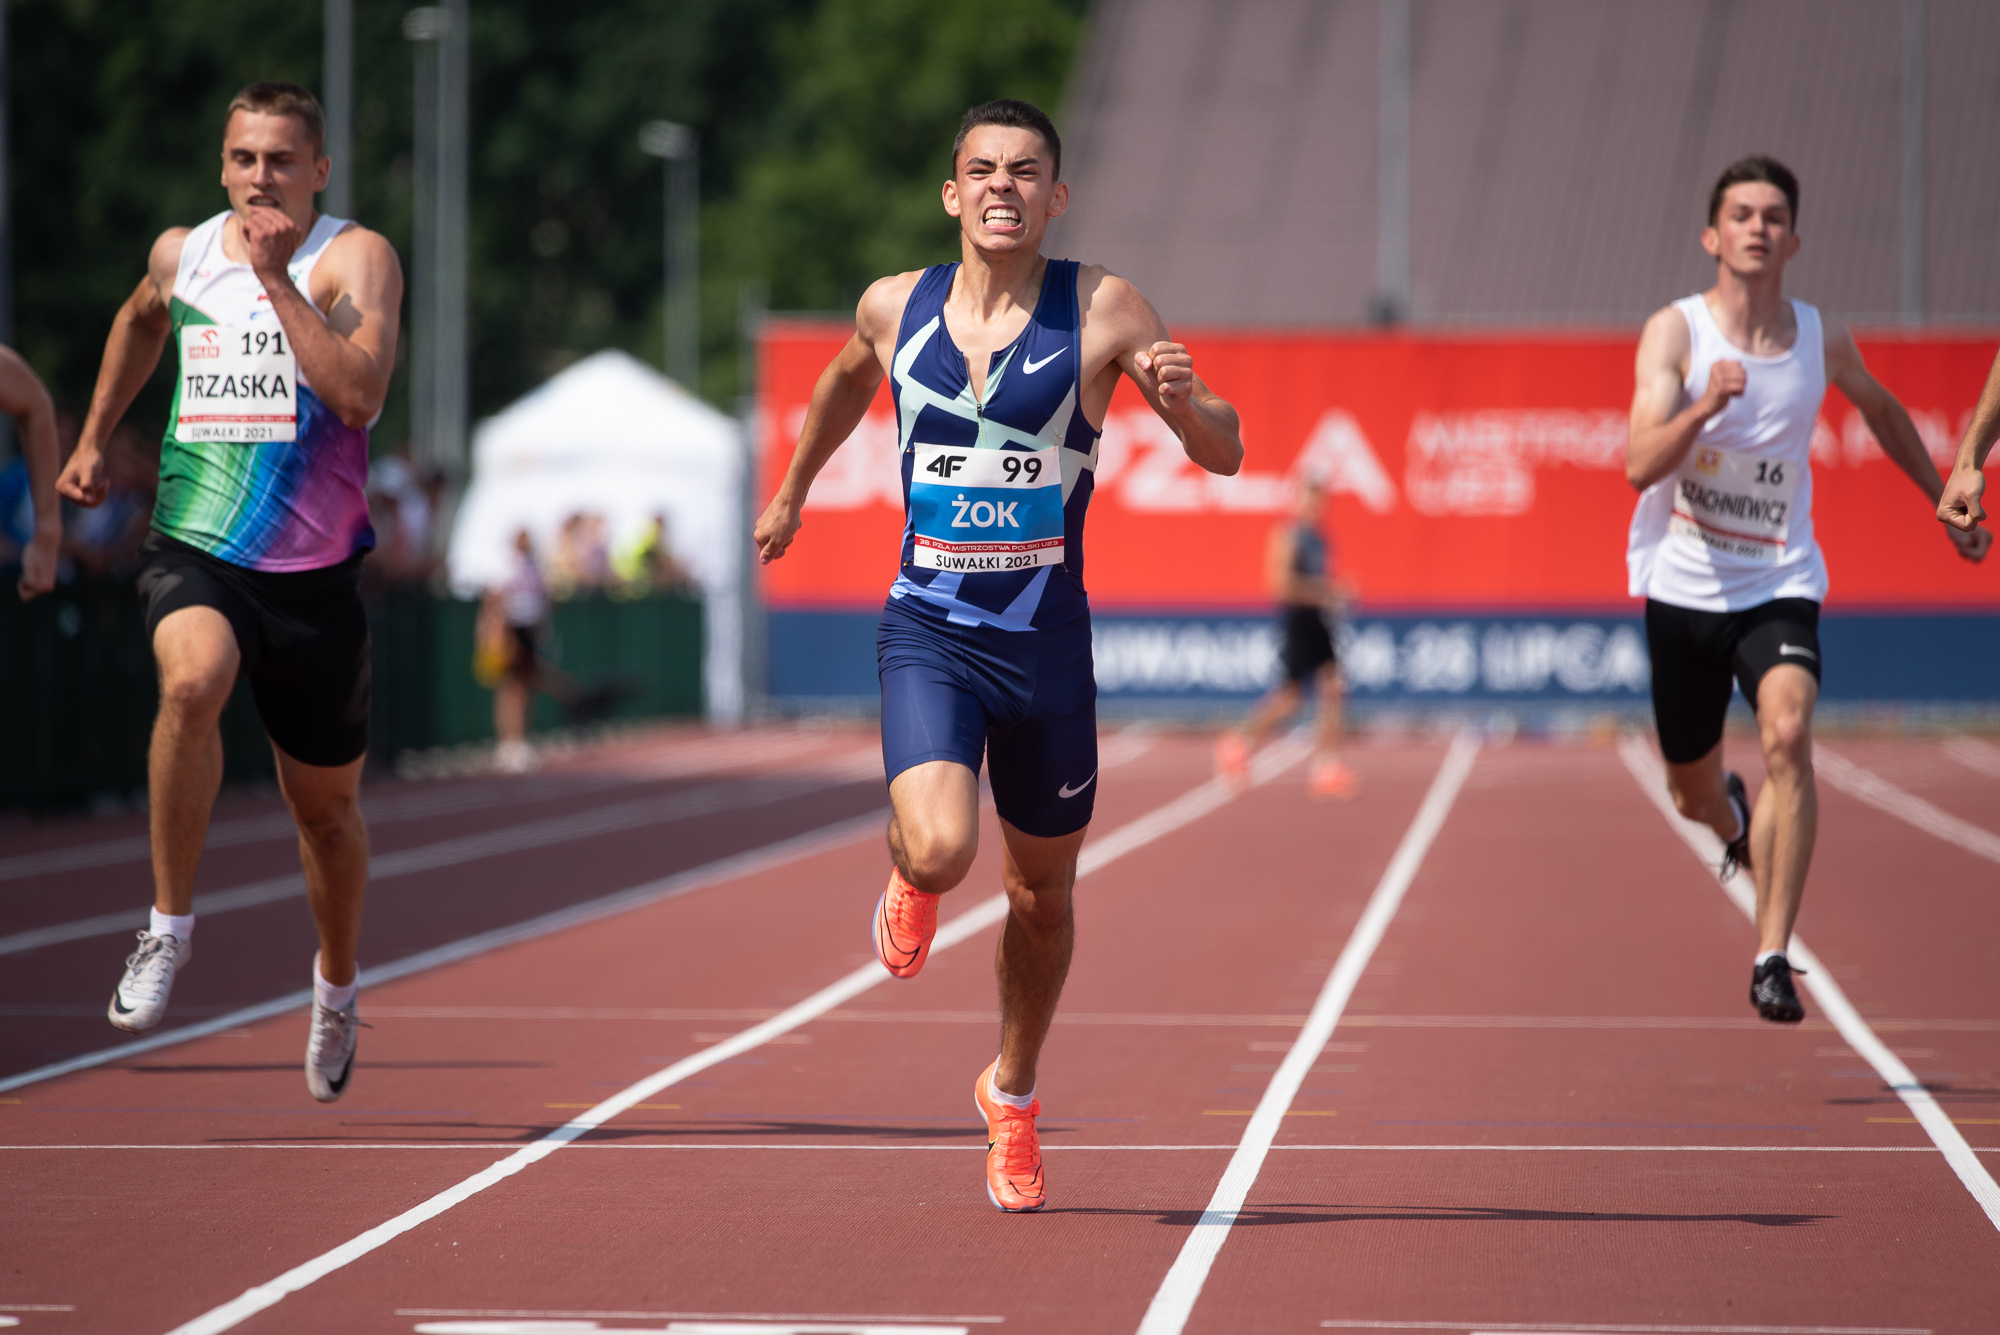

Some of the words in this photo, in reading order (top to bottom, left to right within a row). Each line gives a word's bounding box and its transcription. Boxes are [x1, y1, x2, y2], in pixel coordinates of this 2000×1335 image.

[241, 331, 286, 355] 191
[186, 374, 289, 399] TRZASKA
[244, 427, 273, 439] 2021
[926, 454, 968, 479] 4F
[1002, 456, 1042, 483] 99
[1754, 460, 1784, 485] 16
[951, 493, 1020, 528] ŻOK
[932, 540, 951, 551] PZLA
[951, 544, 1011, 552] MISTRZOSTWA
[1011, 542, 1040, 552] POLSKI
[1041, 539, 1059, 548] U23
[935, 554, 1000, 570] SUWAŁKI
[1004, 553, 1039, 569] 2021
